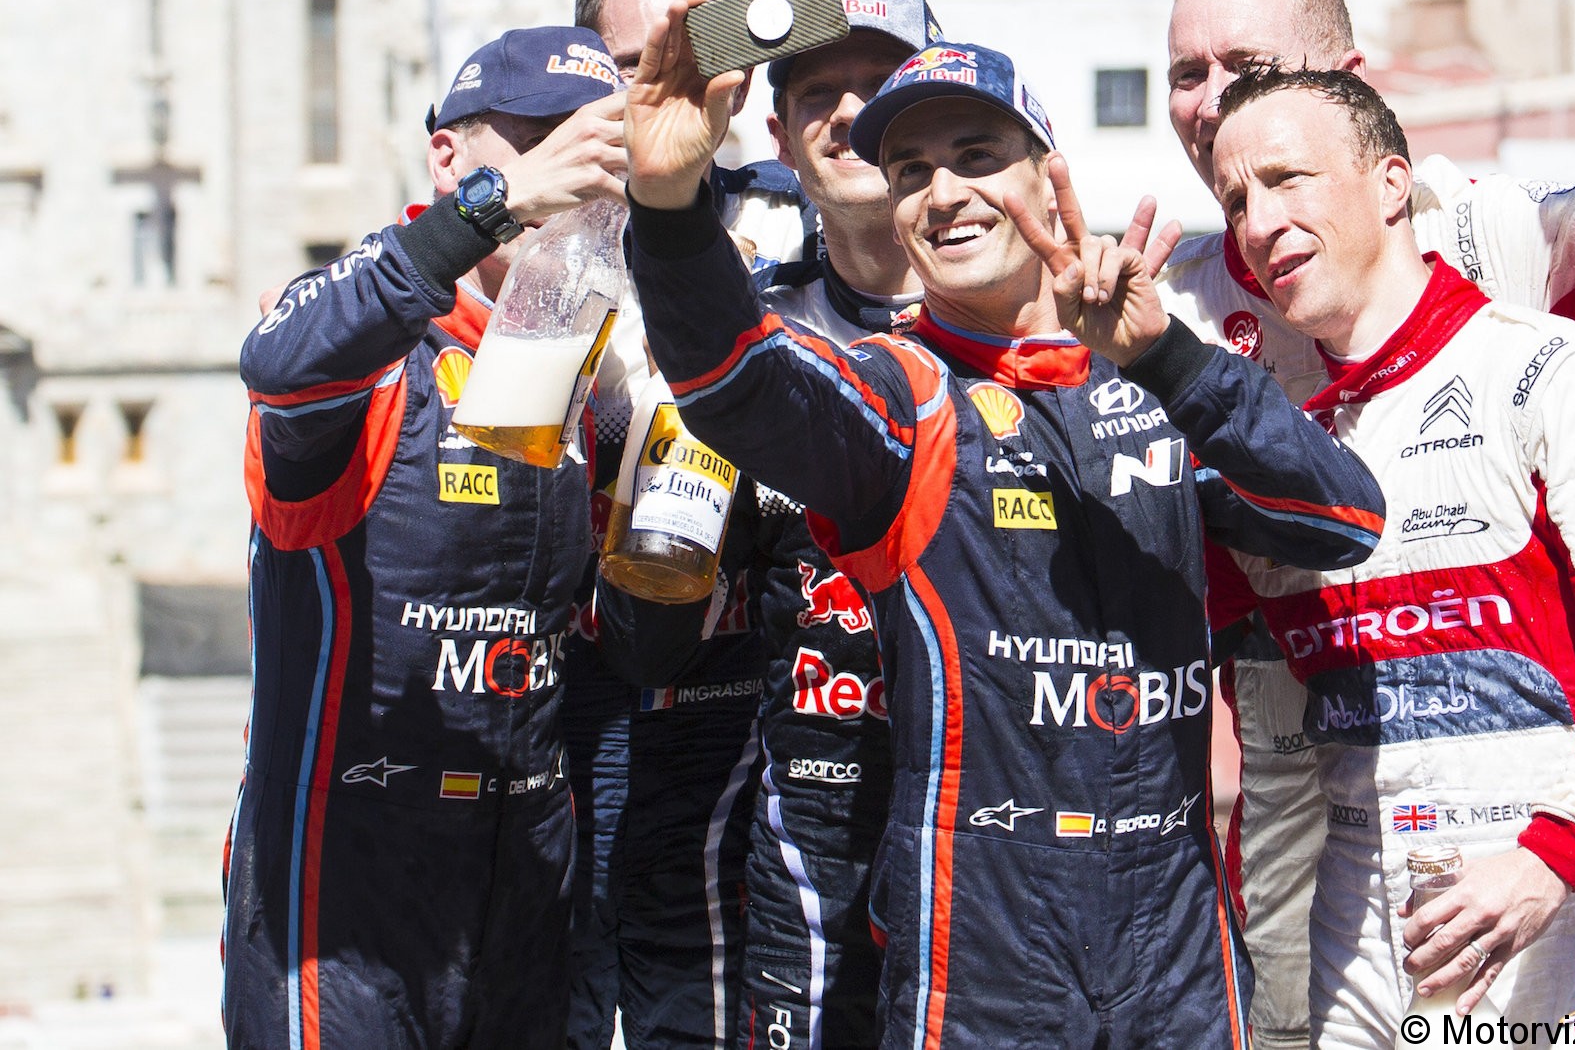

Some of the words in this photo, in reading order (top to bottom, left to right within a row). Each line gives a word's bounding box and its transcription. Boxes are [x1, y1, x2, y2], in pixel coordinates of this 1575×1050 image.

[845, 0, 887, 18] Bull
[930, 67, 977, 86] Bull
[1512, 336, 1569, 410] sparco
[1400, 433, 1484, 459] CITROËN
[649, 436, 731, 484] Corona
[445, 472, 494, 496] RACC
[666, 471, 713, 501] Light
[997, 497, 1052, 520] RACC
[1411, 507, 1432, 521] Abu
[1435, 502, 1468, 518] Dhabi
[401, 602, 536, 634] HYUNDAI
[1285, 588, 1513, 659] CITROËN
[988, 630, 1135, 669] HYUNDAI
[678, 678, 765, 703] INGRASSIA
[1029, 659, 1207, 735] MOBIS
[788, 758, 862, 783] sparco
[1446, 809, 1464, 825] K.
[768, 1002, 792, 1050] FO
